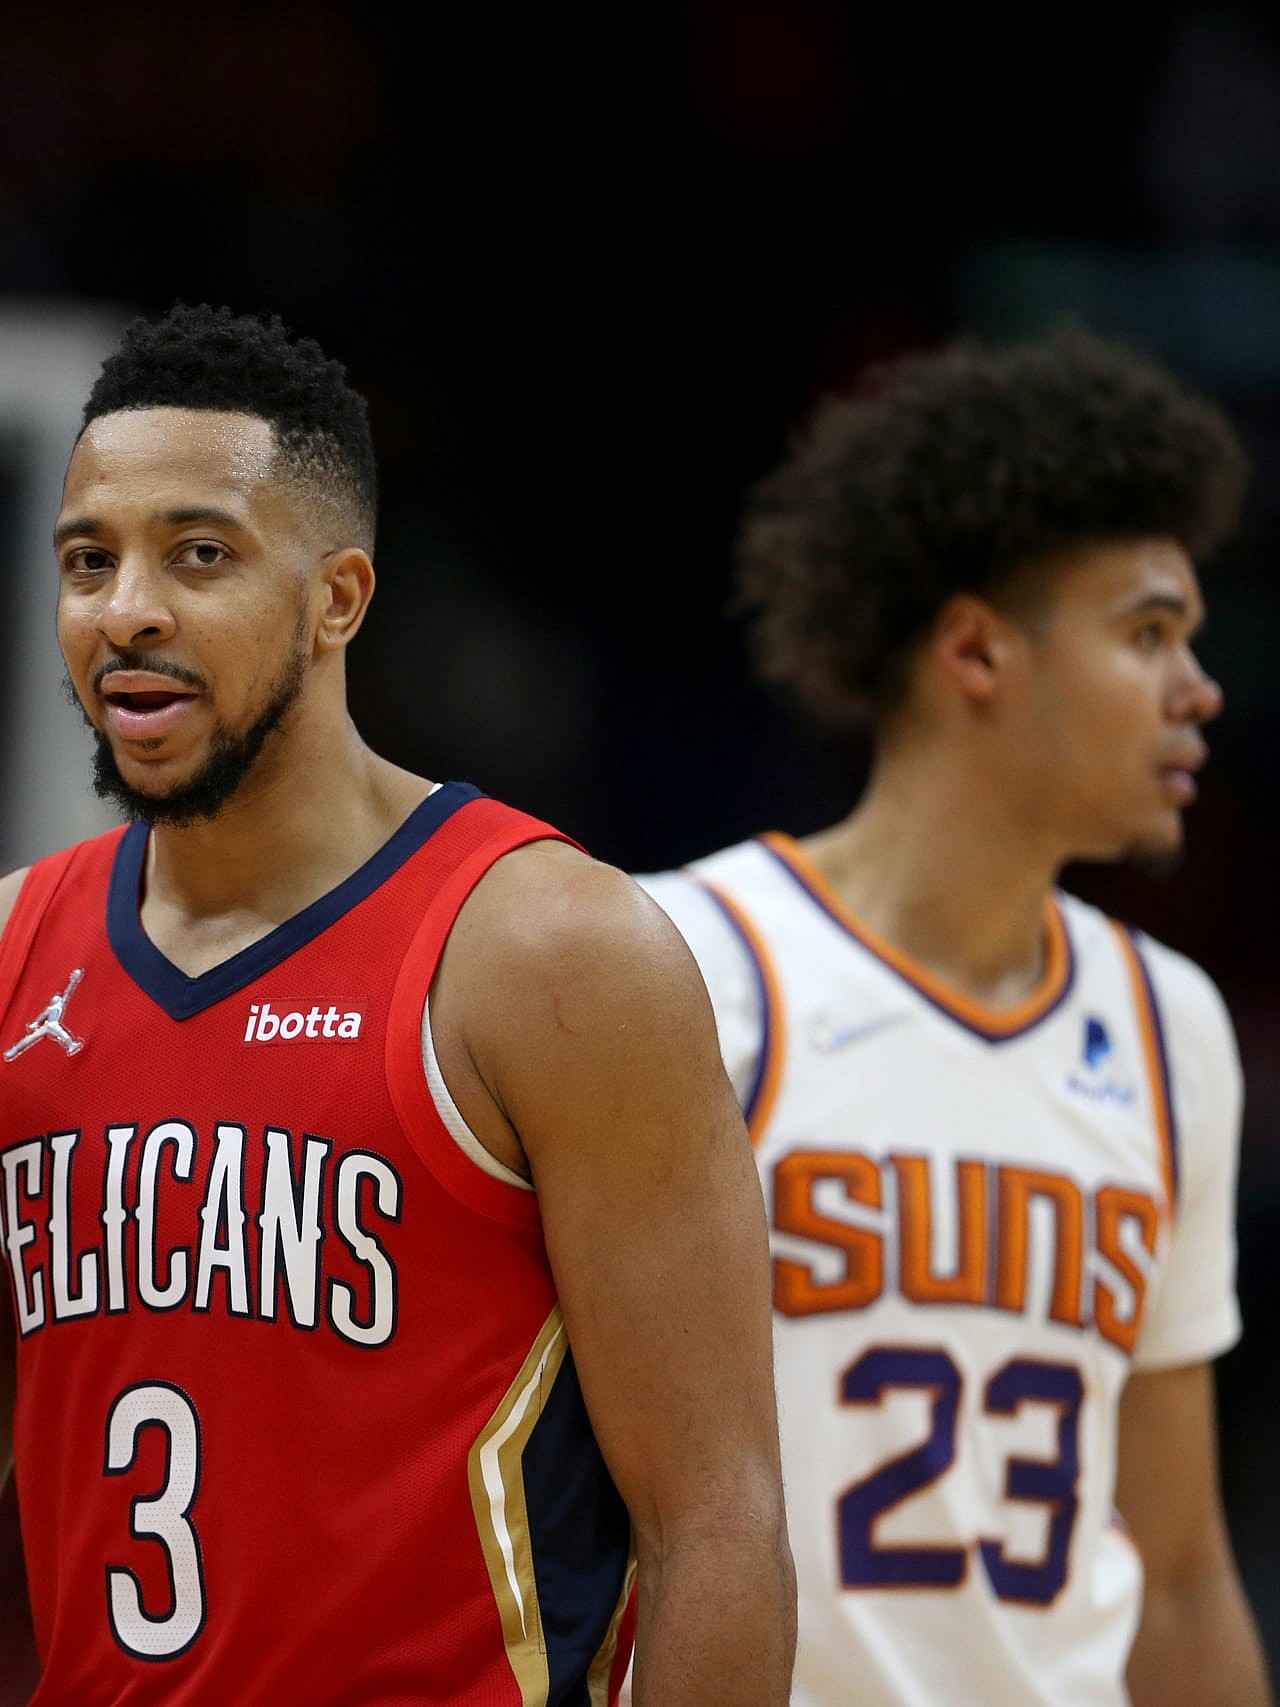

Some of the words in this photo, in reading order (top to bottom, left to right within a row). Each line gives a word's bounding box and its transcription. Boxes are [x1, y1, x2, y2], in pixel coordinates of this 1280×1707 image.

[243, 1003, 362, 1042] ibotta
[772, 1146, 1160, 1356] SUNS
[103, 1378, 208, 1673] 3
[835, 1344, 1086, 1610] 23
